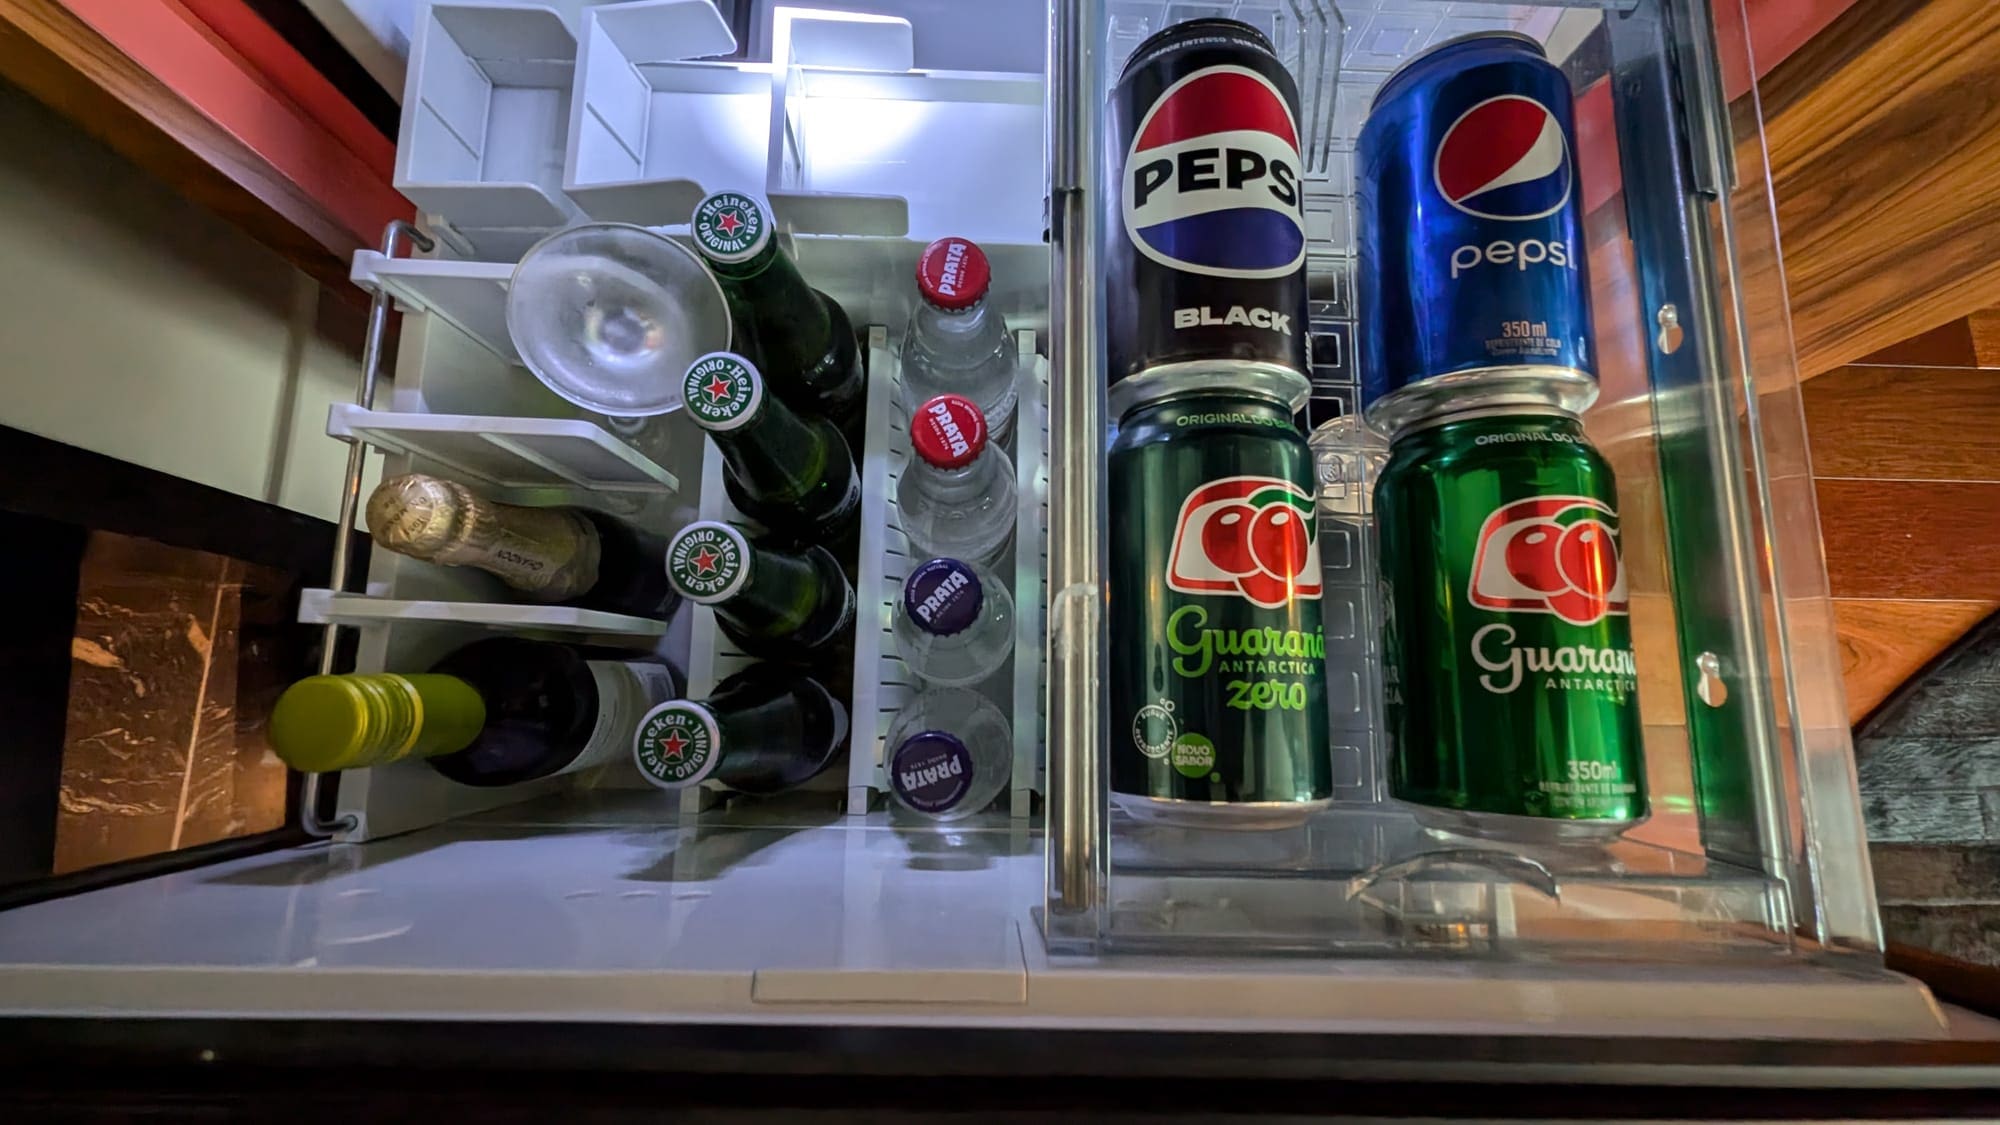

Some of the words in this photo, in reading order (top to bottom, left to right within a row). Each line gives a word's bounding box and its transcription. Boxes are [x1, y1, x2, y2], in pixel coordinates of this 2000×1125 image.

[702, 195, 758, 235] Heineken
[699, 222, 747, 252] ORIGINAL
[938, 243, 967, 296] PRATA
[1173, 305, 1292, 336] BLACK
[1502, 320, 1530, 338] 350
[1532, 320, 1548, 337] ml
[687, 360, 725, 402] ORIGINAL
[701, 365, 751, 417] Heineken
[928, 402, 969, 458] PRATA
[1176, 413, 1252, 427] ORIGINAL
[1475, 432, 1552, 445] ORIGINAL
[673, 530, 715, 572] ORIGINAL
[685, 538, 739, 592] Heineken
[916, 570, 969, 623] PRATA
[1167, 604, 1325, 678] Guaraná
[1219, 660, 1316, 675] ANTARCTICA
[1226, 678, 1307, 711] zero
[641, 714, 686, 777] Heineken
[675, 724, 707, 778] ORIGINAL
[900, 754, 962, 791] PRATA
